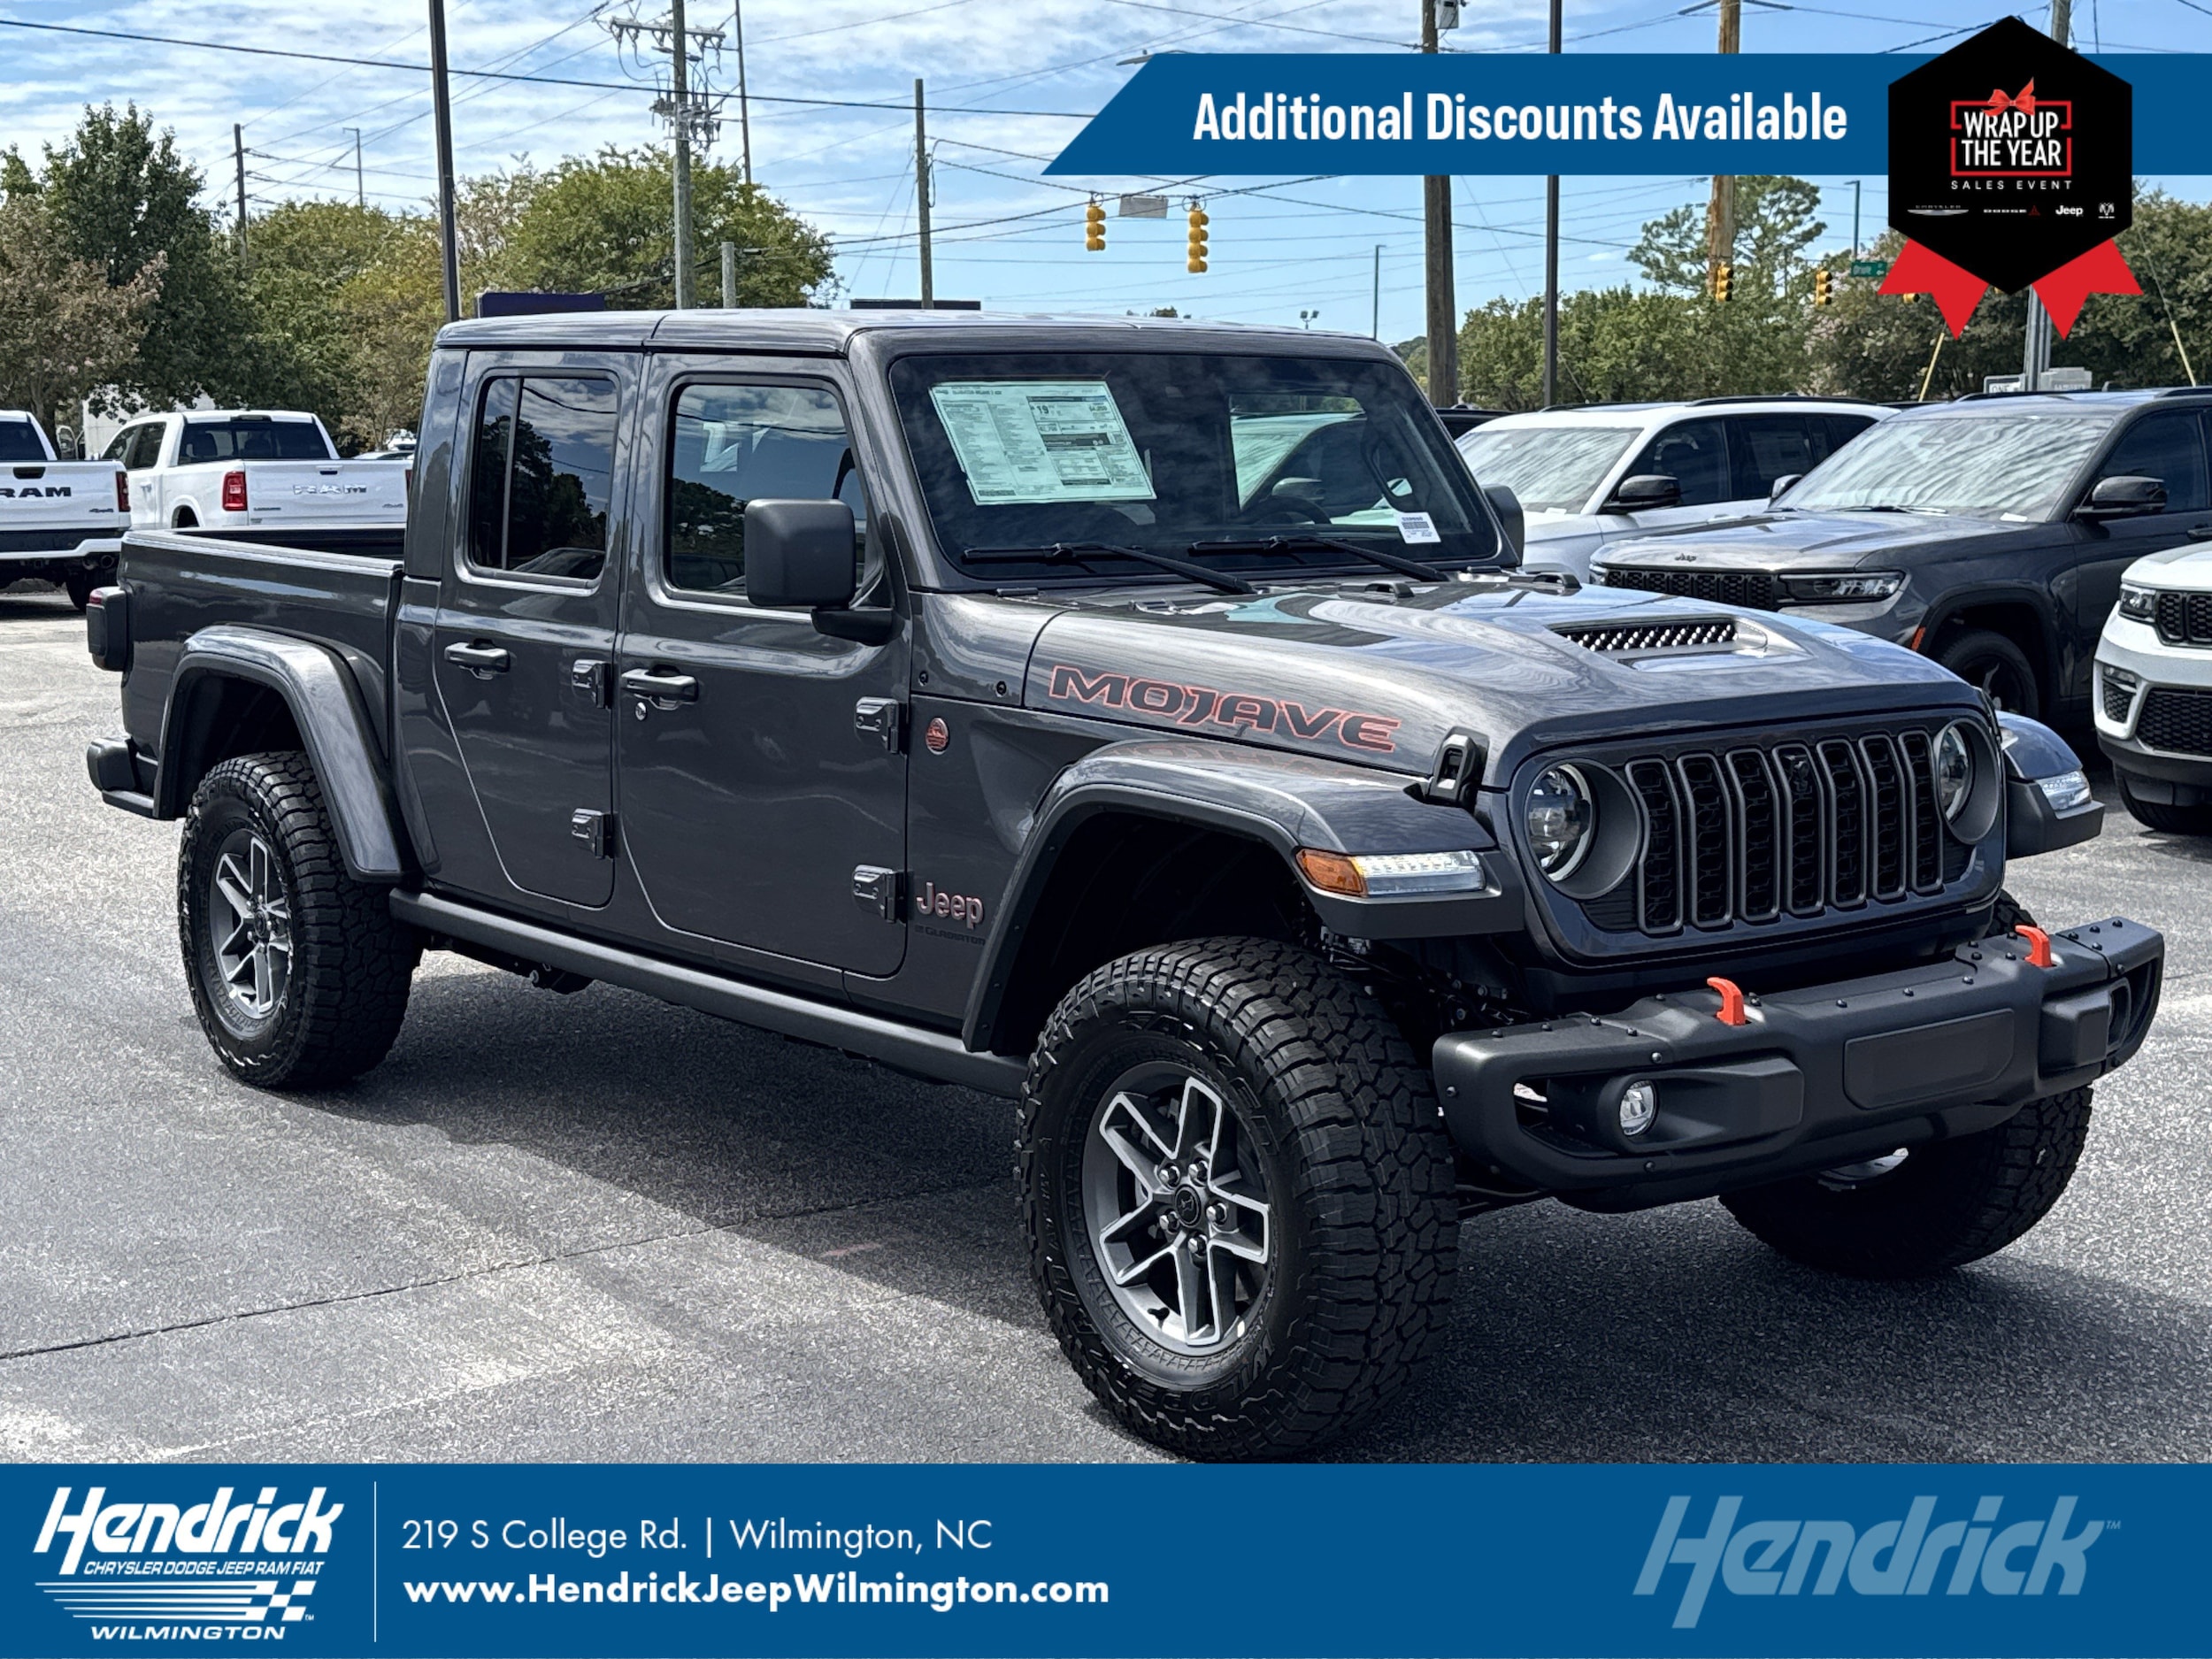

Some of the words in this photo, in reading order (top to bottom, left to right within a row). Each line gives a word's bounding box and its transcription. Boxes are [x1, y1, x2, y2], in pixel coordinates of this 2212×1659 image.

[0, 487, 73, 498] RAM
[1048, 664, 1402, 753] MOJAVE
[916, 881, 984, 930] Jeep
[925, 926, 987, 947] GLADIATOR
